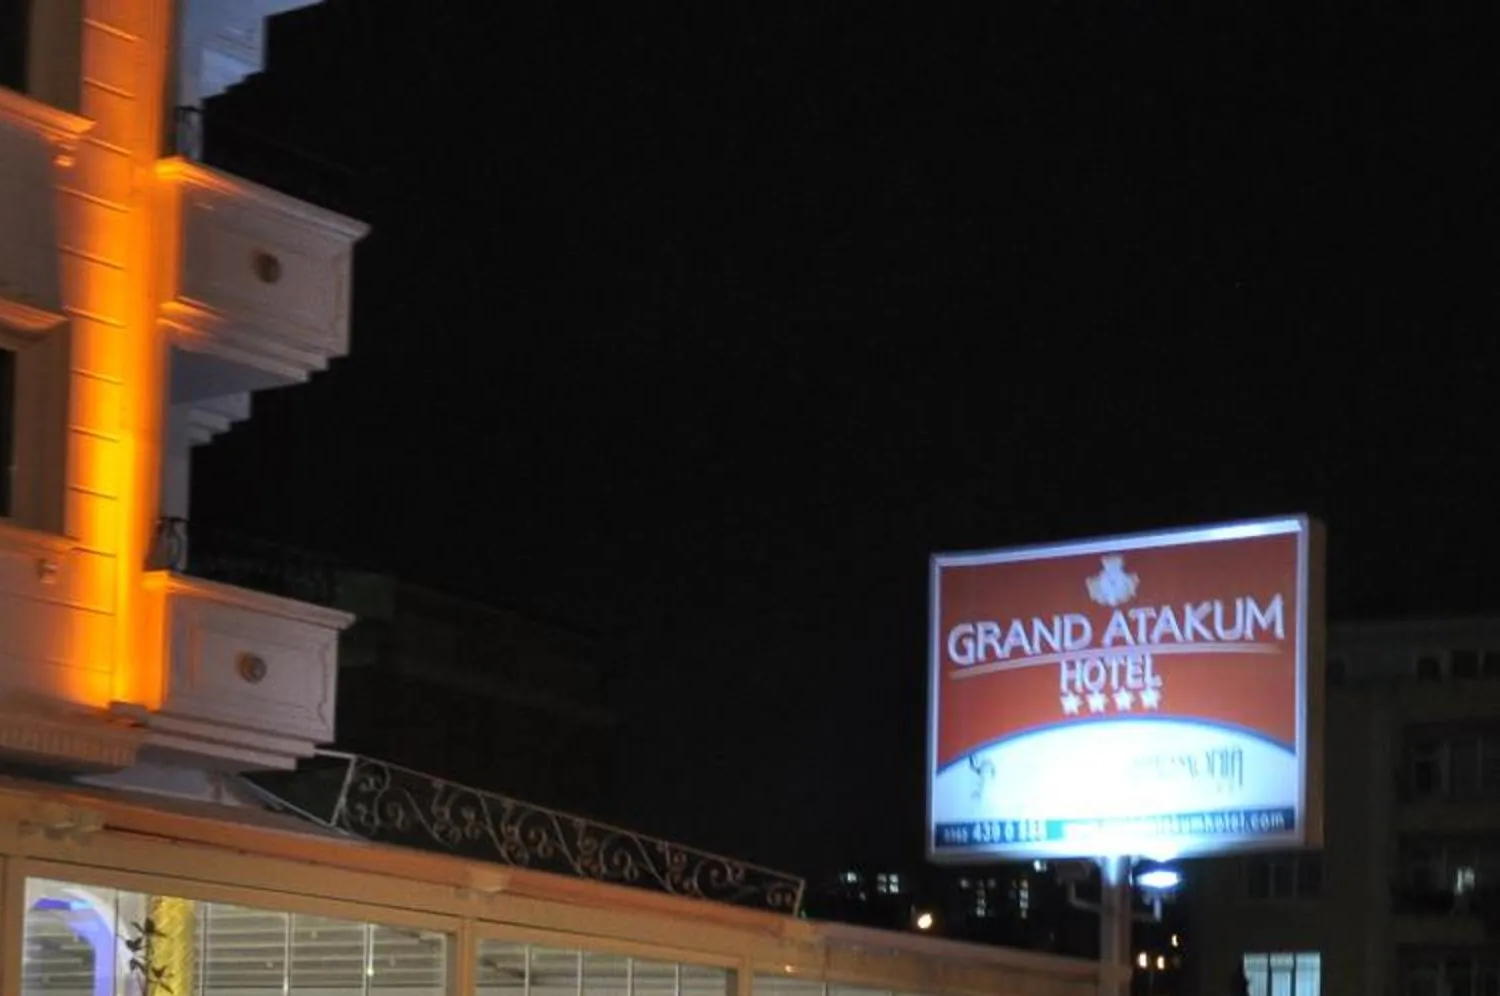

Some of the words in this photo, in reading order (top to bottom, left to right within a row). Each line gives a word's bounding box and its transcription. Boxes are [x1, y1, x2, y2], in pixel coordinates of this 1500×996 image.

[947, 613, 1093, 666] GRAND
[1102, 593, 1285, 648] ATAKUM
[1059, 652, 1163, 693] HOTEL
